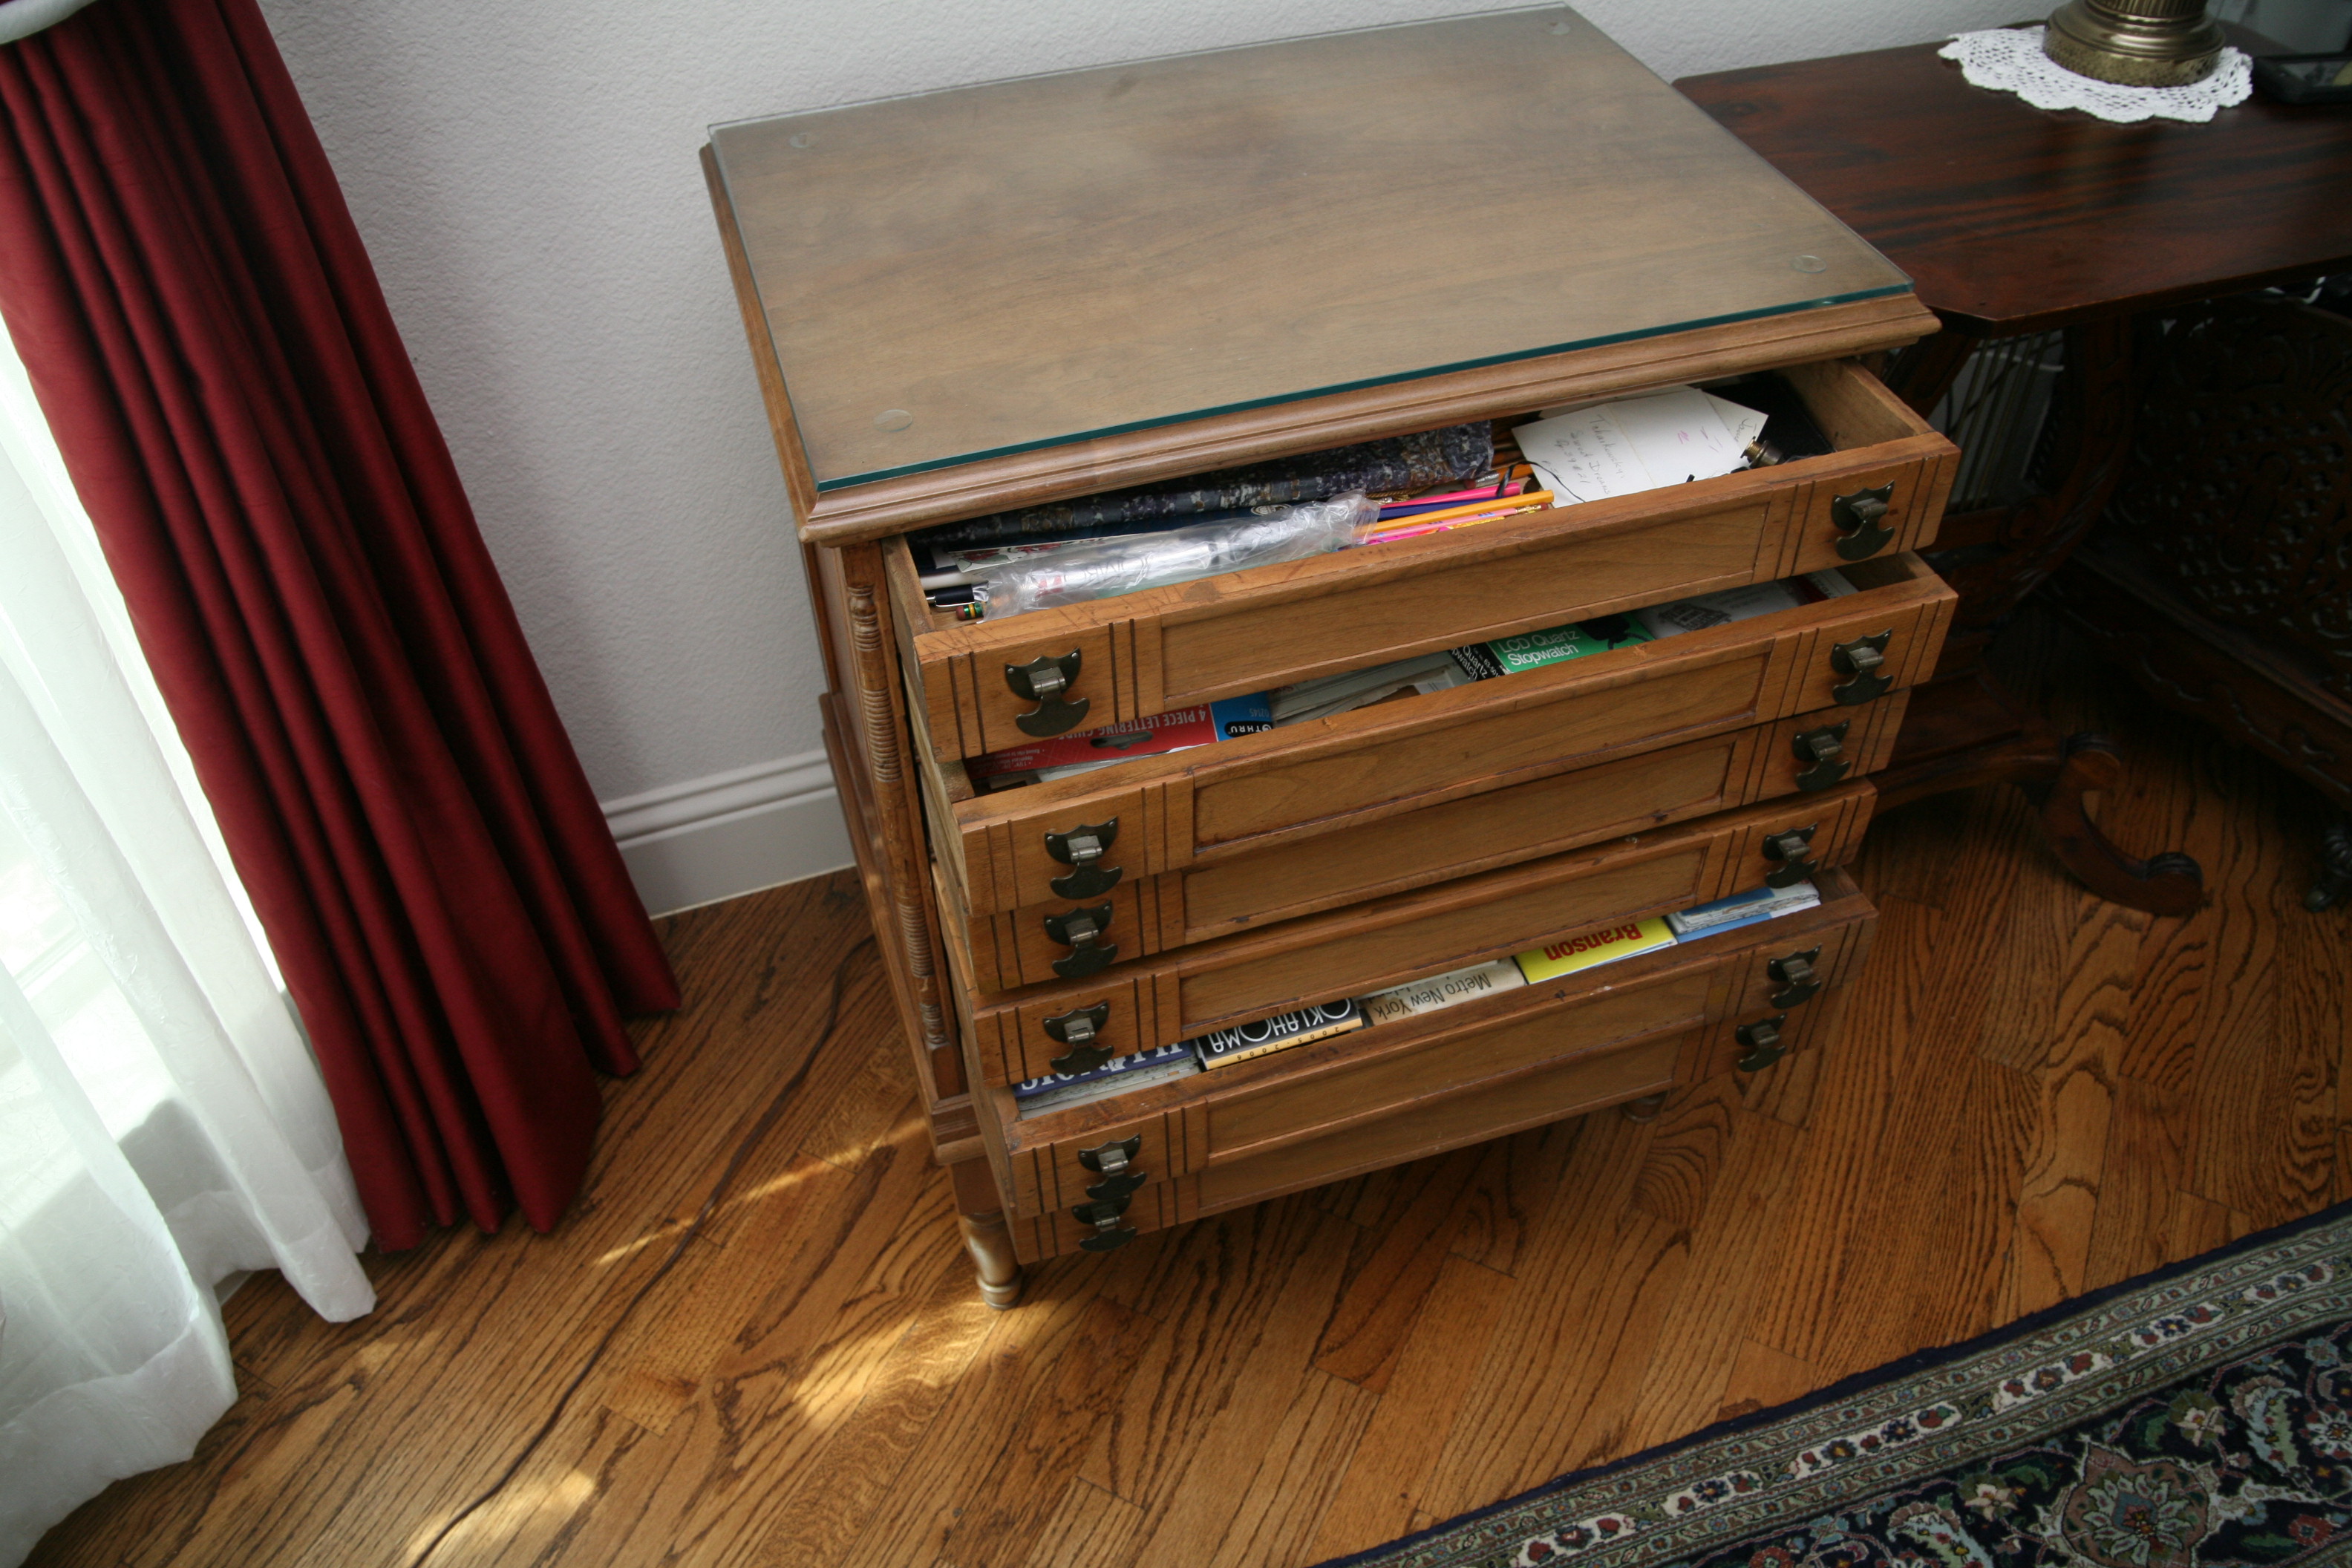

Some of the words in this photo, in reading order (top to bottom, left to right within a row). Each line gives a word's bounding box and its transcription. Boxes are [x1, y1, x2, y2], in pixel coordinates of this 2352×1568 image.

[1497, 637, 1531, 653] LCD
[1531, 630, 1581, 647] Quartz
[1463, 644, 1488, 679] Quartz
[1507, 643, 1580, 666] Stopwatch
[1163, 710, 1196, 726] PIECE
[1198, 710, 1206, 722] 4
[1543, 923, 1644, 961] Branson
[1445, 971, 1492, 996] Metro
[1411, 985, 1446, 1008] New
[1375, 996, 1411, 1021] York
